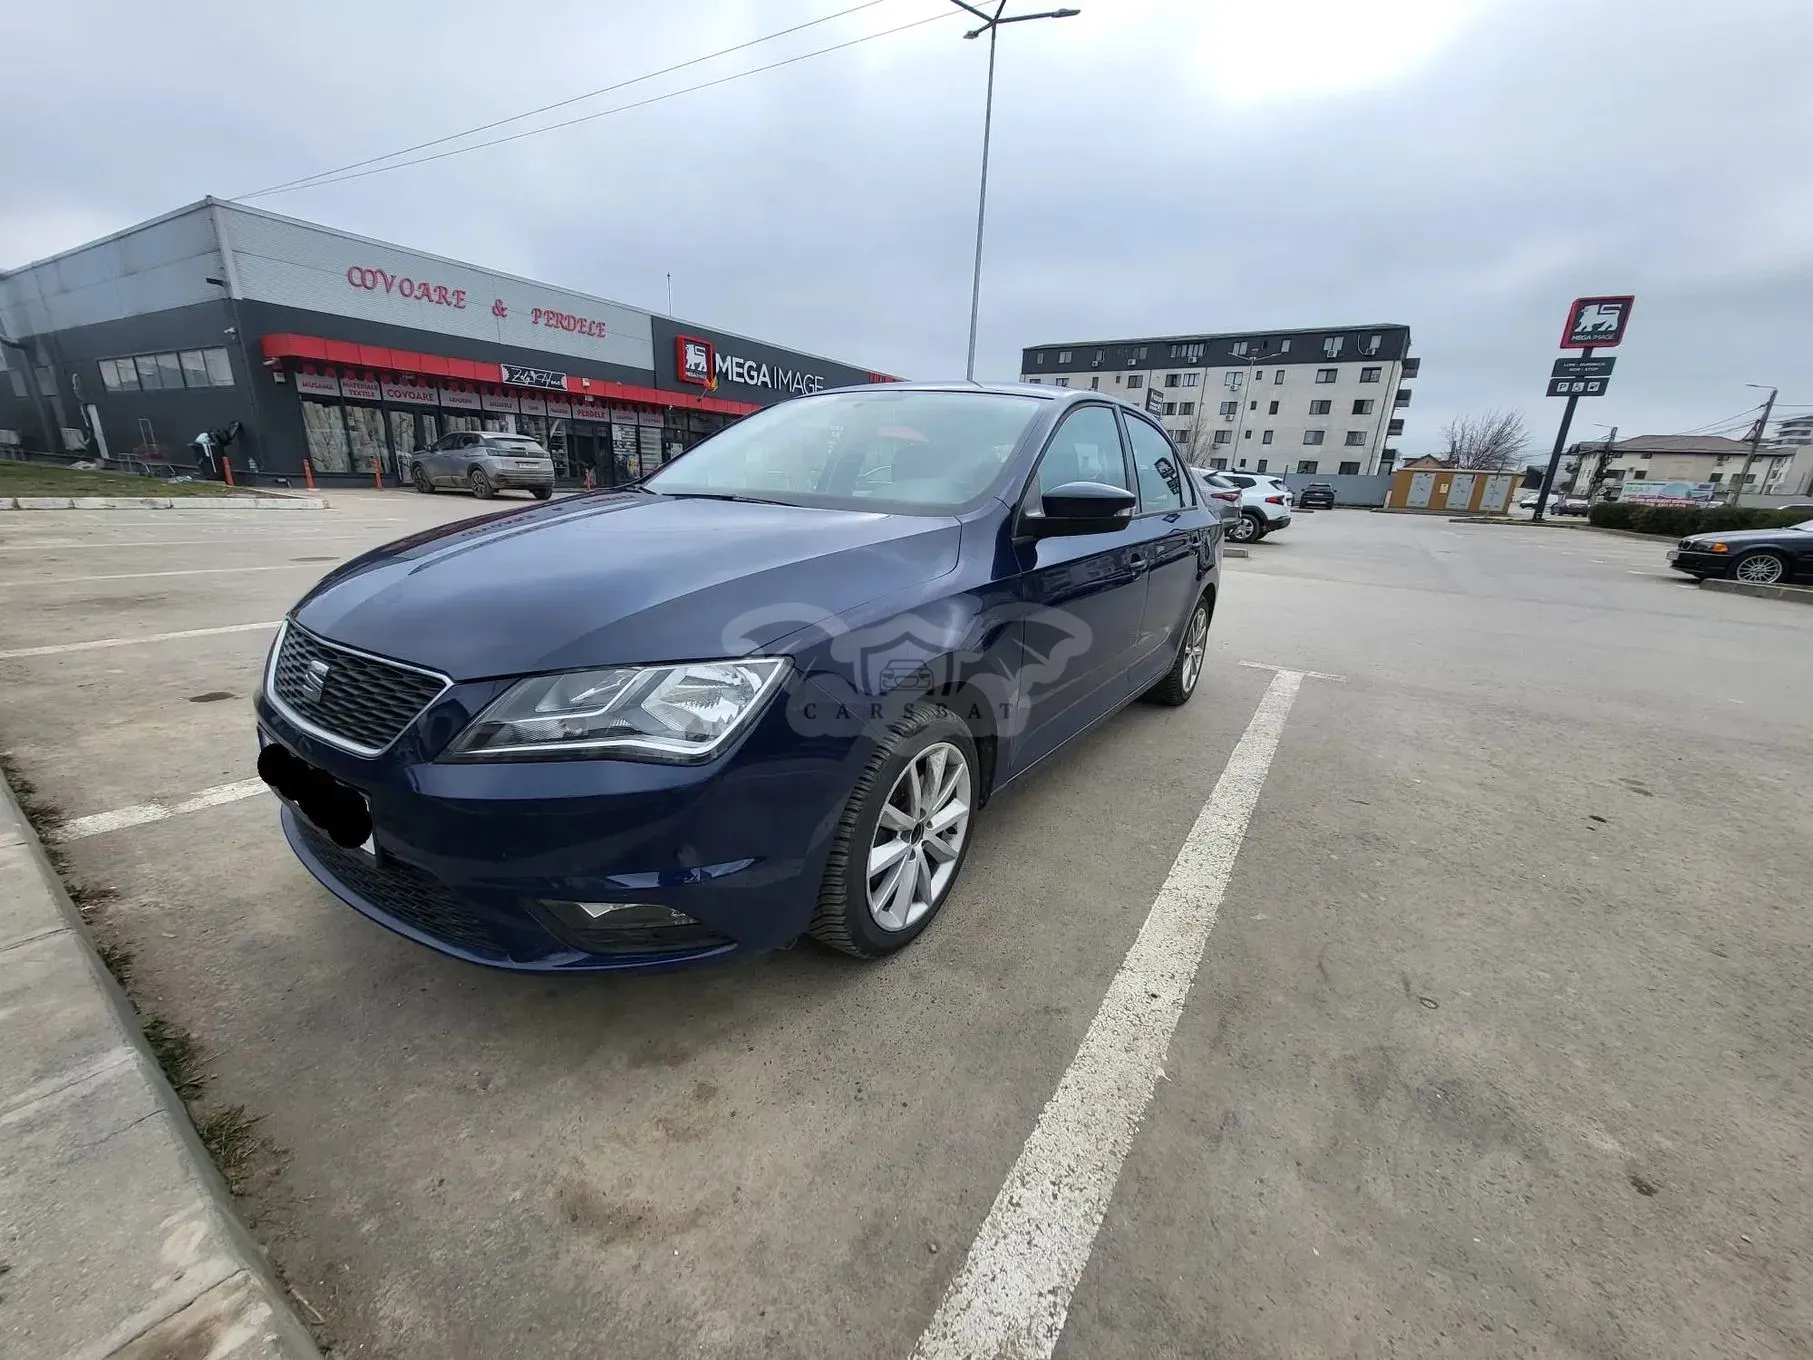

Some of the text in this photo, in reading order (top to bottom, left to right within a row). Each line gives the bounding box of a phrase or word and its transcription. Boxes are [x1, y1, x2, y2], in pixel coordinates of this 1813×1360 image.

[347, 266, 606, 338] COVOARE & PERDELE
[715, 353, 825, 394] MEGA IMAGE
[386, 389, 434, 401] COVOARE
[577, 409, 605, 418] PERDELE
